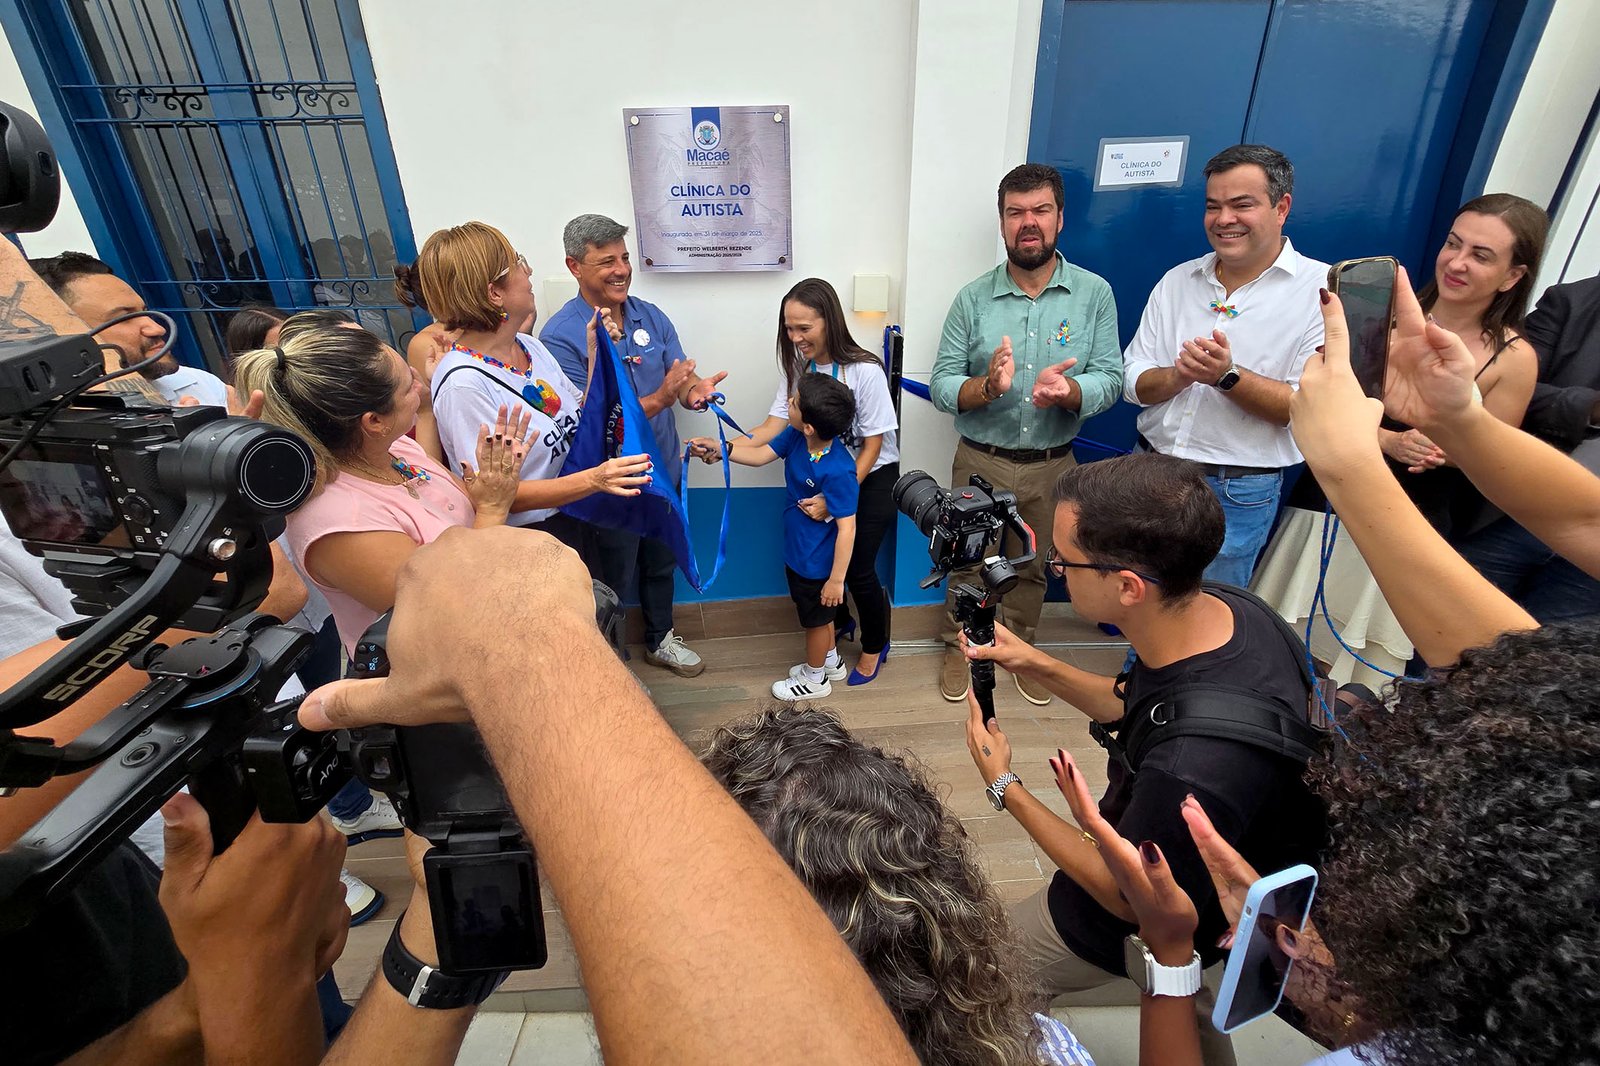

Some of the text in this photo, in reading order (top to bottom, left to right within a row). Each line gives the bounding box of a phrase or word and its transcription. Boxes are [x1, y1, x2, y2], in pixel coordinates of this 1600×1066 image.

[687, 148, 730, 161] Macaé
[1120, 160, 1162, 169] CLÍNICA DO
[671, 183, 751, 197] CLÍNICA DO
[681, 203, 743, 217] AUTISTA
[42, 614, 158, 701] SCORP
